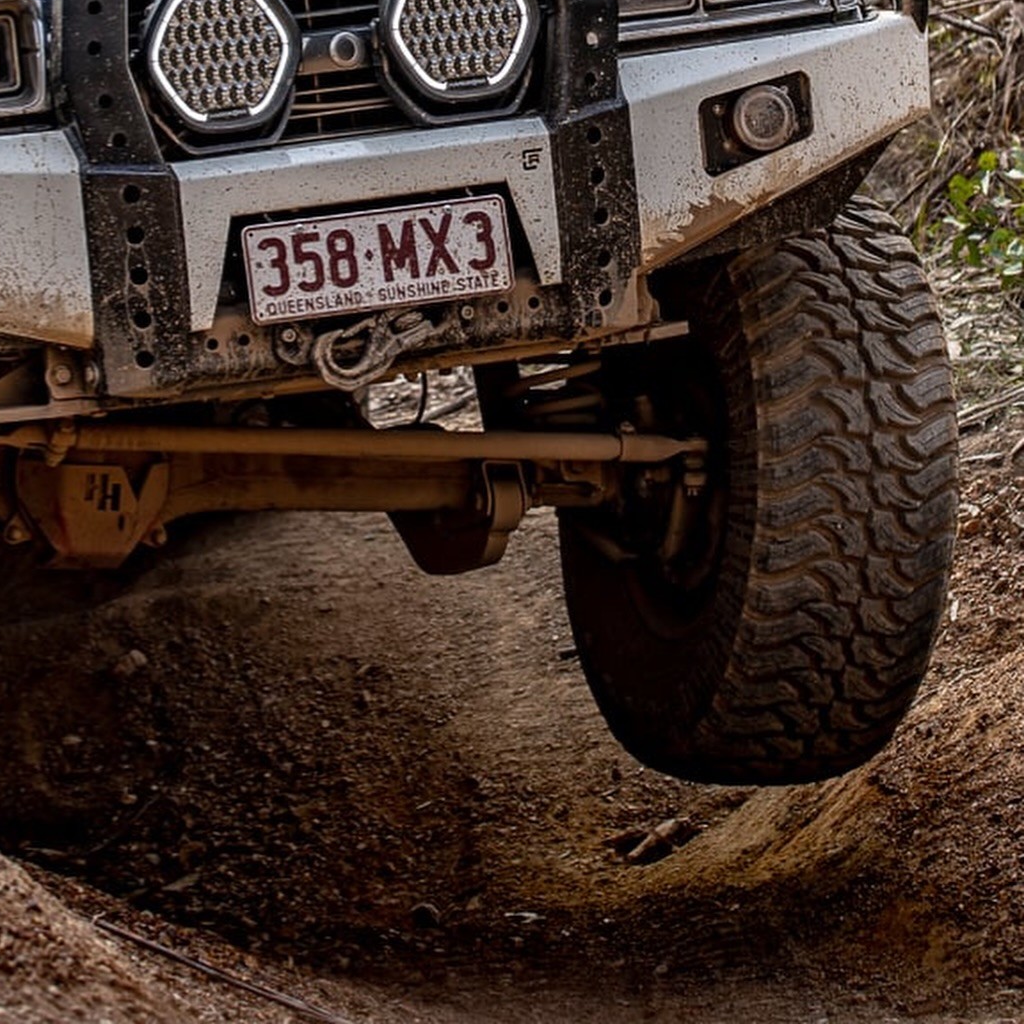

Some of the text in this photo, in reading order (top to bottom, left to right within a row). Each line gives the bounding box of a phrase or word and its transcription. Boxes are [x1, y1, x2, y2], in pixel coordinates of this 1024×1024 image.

[267, 274, 499, 315] QUEENSLAND SUNSHINE STATE
